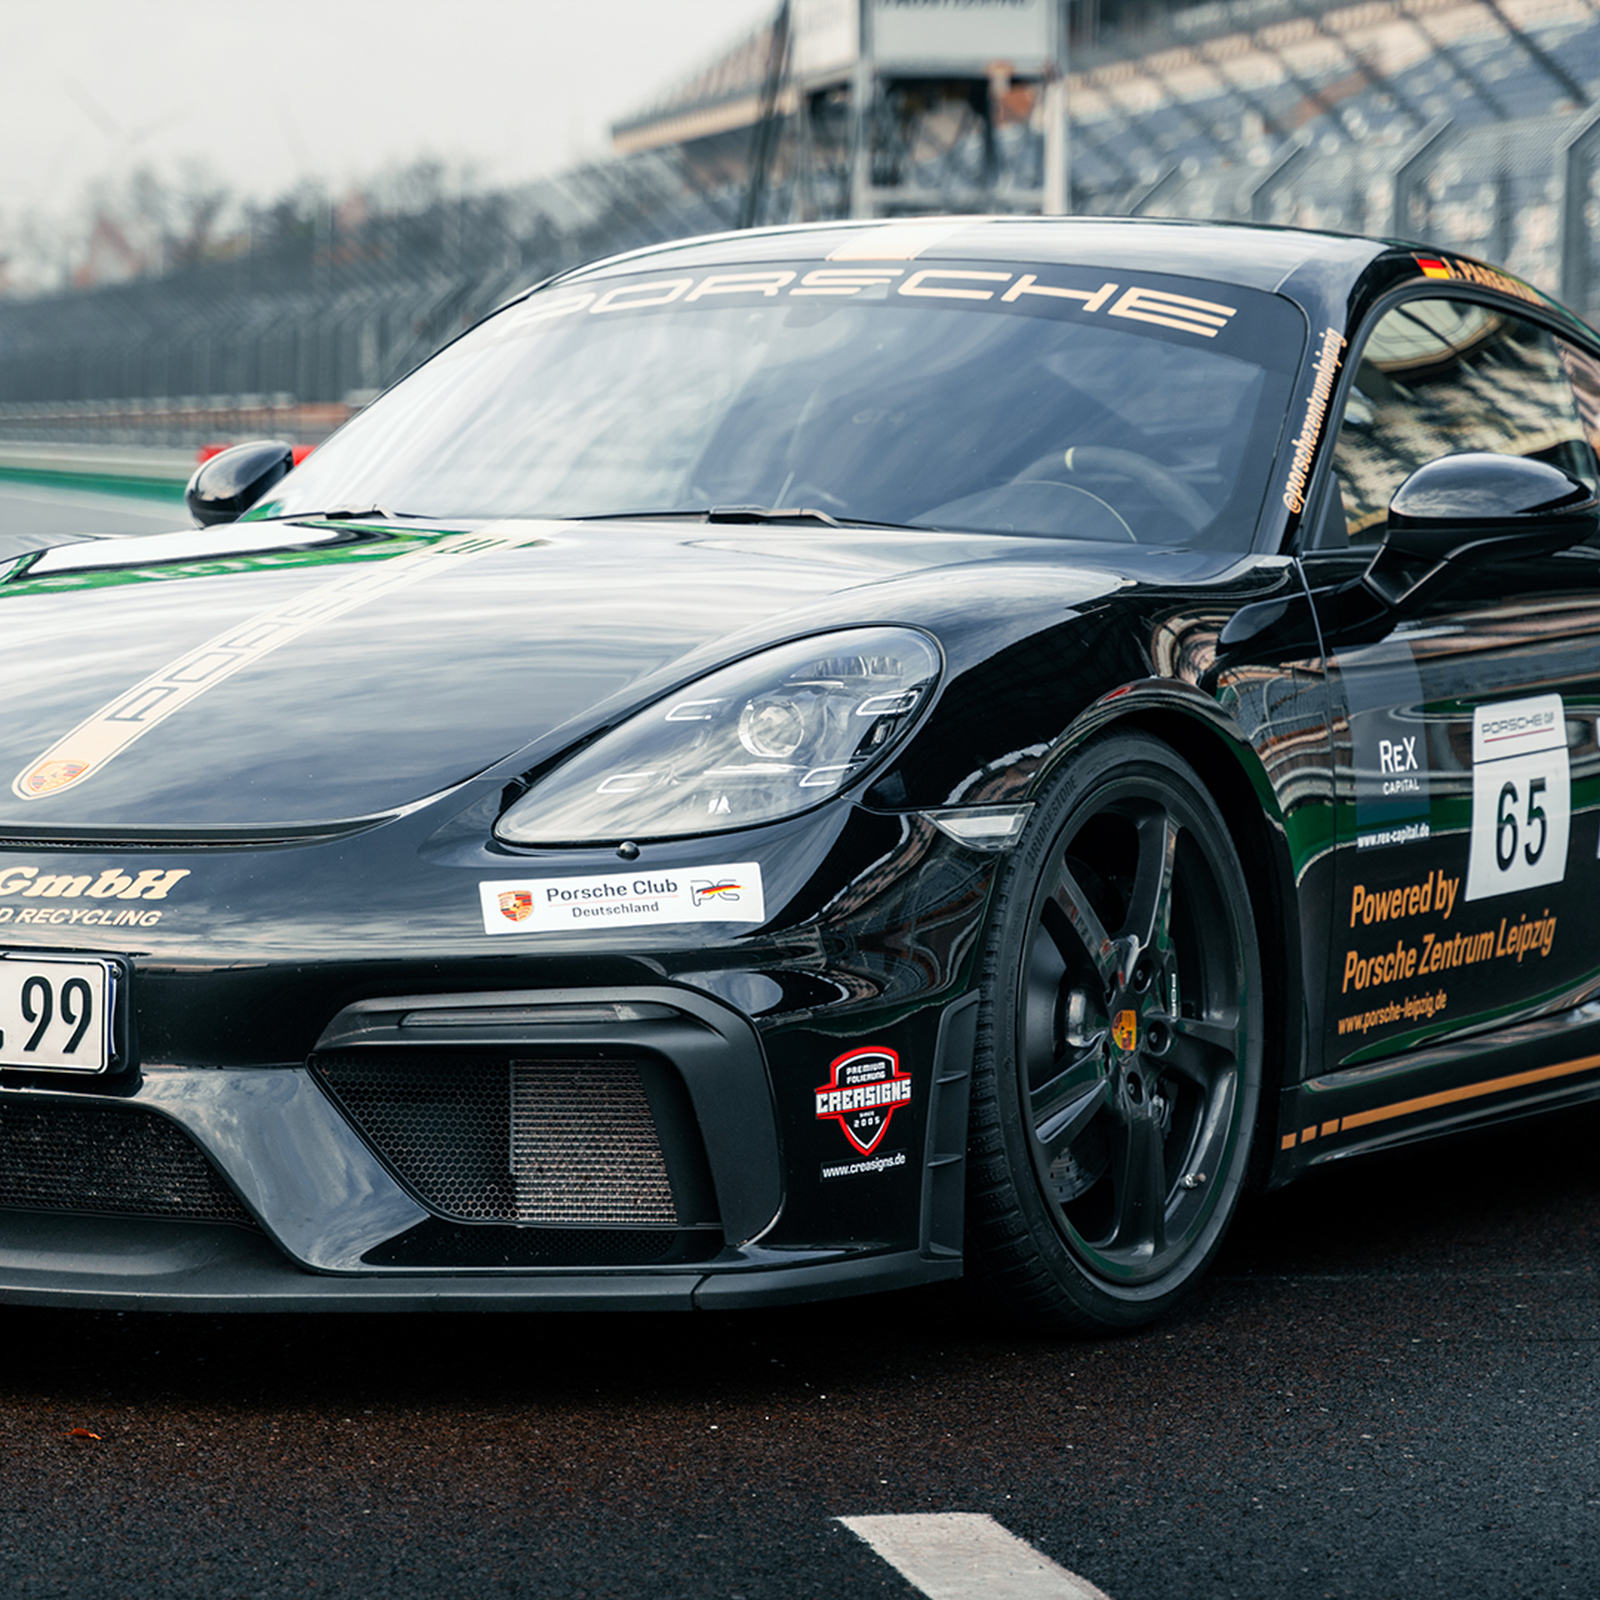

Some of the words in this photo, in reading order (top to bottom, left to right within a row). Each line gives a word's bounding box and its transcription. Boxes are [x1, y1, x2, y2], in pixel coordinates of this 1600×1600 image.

[495, 268, 1237, 339] PORSCHE
[1283, 327, 1348, 514] @porschezentrumleipzig
[104, 537, 510, 722] PORSCHE
[1481, 713, 1543, 735] PORSCHE
[1383, 779, 1420, 796] CAPITAL
[1025, 774, 1079, 870] BRIDGESTONE
[1357, 822, 1430, 848] www.rex-capital.de
[1496, 776, 1548, 872] 65
[0, 866, 191, 899] GmbH
[546, 882, 627, 902] Porsche
[632, 879, 679, 896] Club
[1350, 870, 1434, 928] Powered
[1434, 869, 1460, 920] by
[15, 908, 162, 927] RECYCLING
[571, 902, 660, 918] Deutschland
[1342, 940, 1417, 993] Porsche
[1418, 930, 1495, 976] Zentrum
[1495, 909, 1557, 963] Leipzig
[1338, 989, 1448, 1035] www.porsche-leipzig.de
[816, 1078, 911, 1114] CREASIGNS
[853, 1115, 880, 1128] 2005
[822, 1153, 906, 1178] www.creasigns.de
